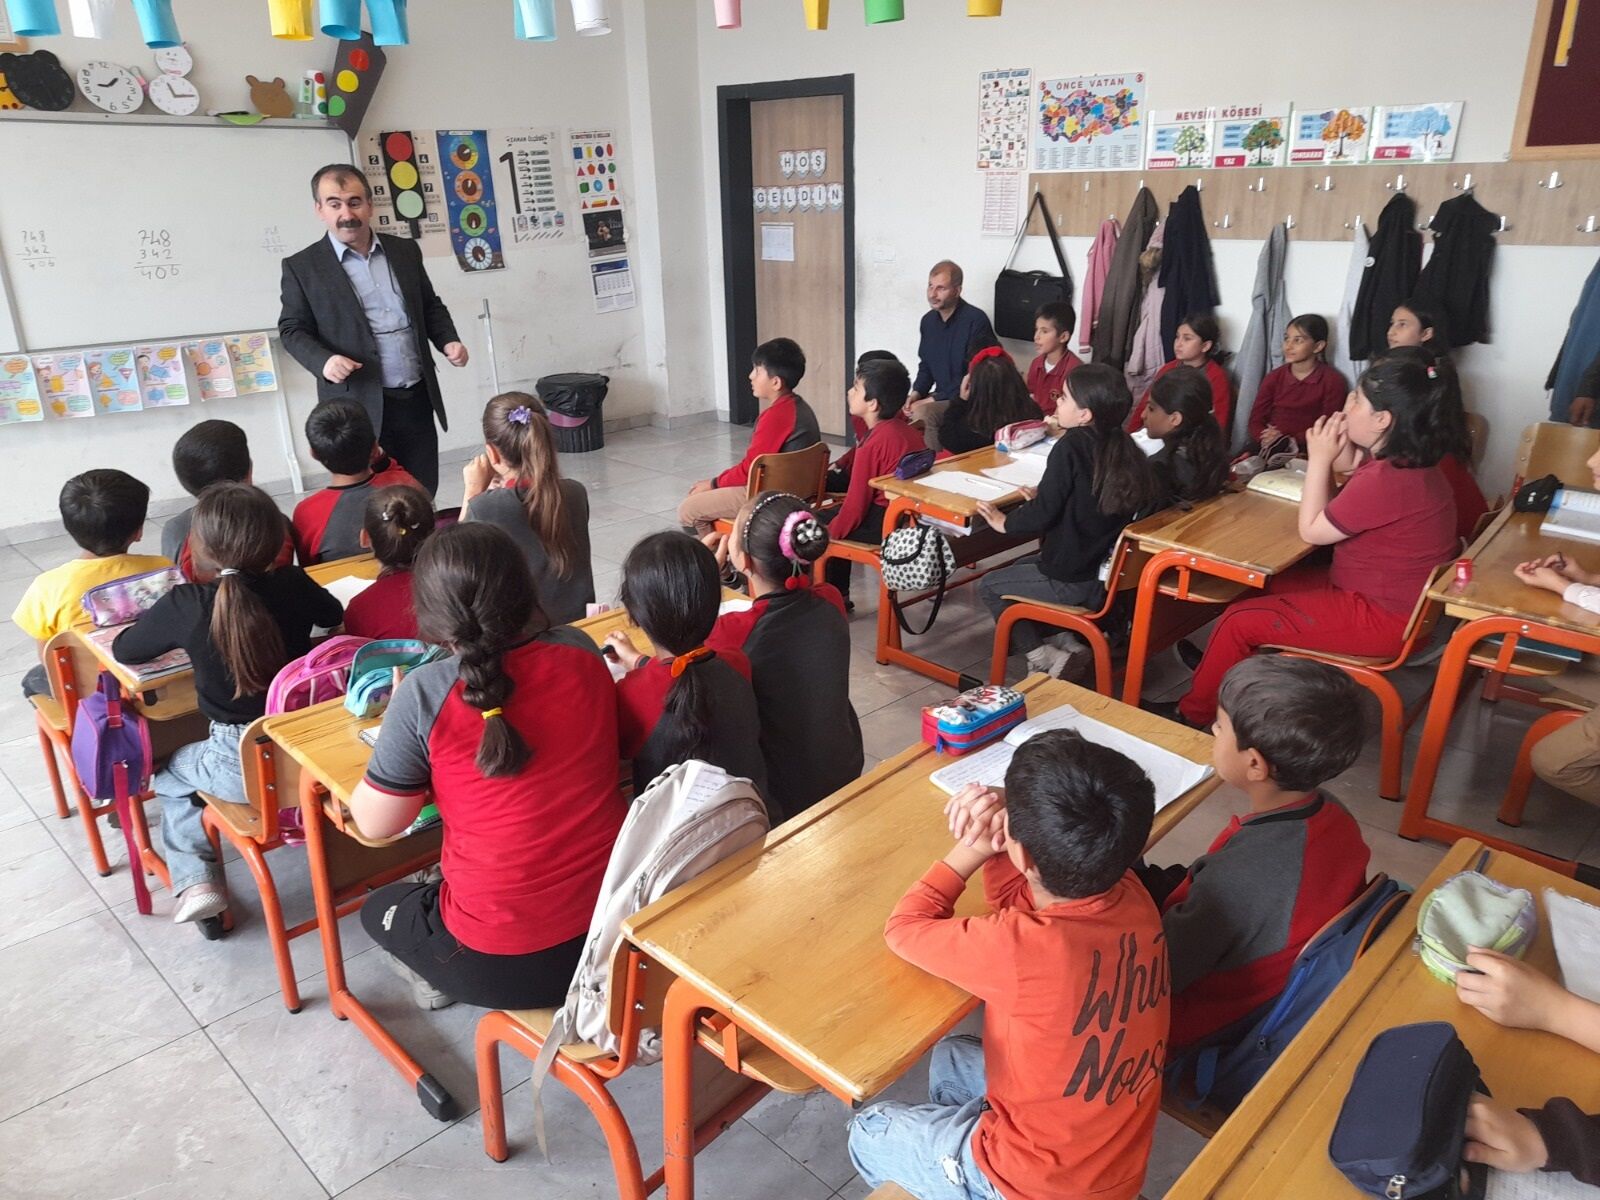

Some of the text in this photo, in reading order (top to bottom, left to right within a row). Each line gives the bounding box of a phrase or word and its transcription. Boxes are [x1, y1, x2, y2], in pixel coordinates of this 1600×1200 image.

[1056, 77, 1125, 90] ÖNCE VATAN
[1222, 104, 1263, 119] KÖŞESİ
[370, 155, 378, 165] 2
[420, 154, 427, 163] 4
[375, 186, 383, 195] 5
[499, 152, 522, 214] 1
[757, 187, 839, 202] GELDİN
[138, 229, 171, 247] 748
[139, 248, 174, 260] 342
[140, 264, 180, 280] 406
[1072, 930, 1170, 1037] Whit
[1063, 1028, 1166, 1106] Nois
